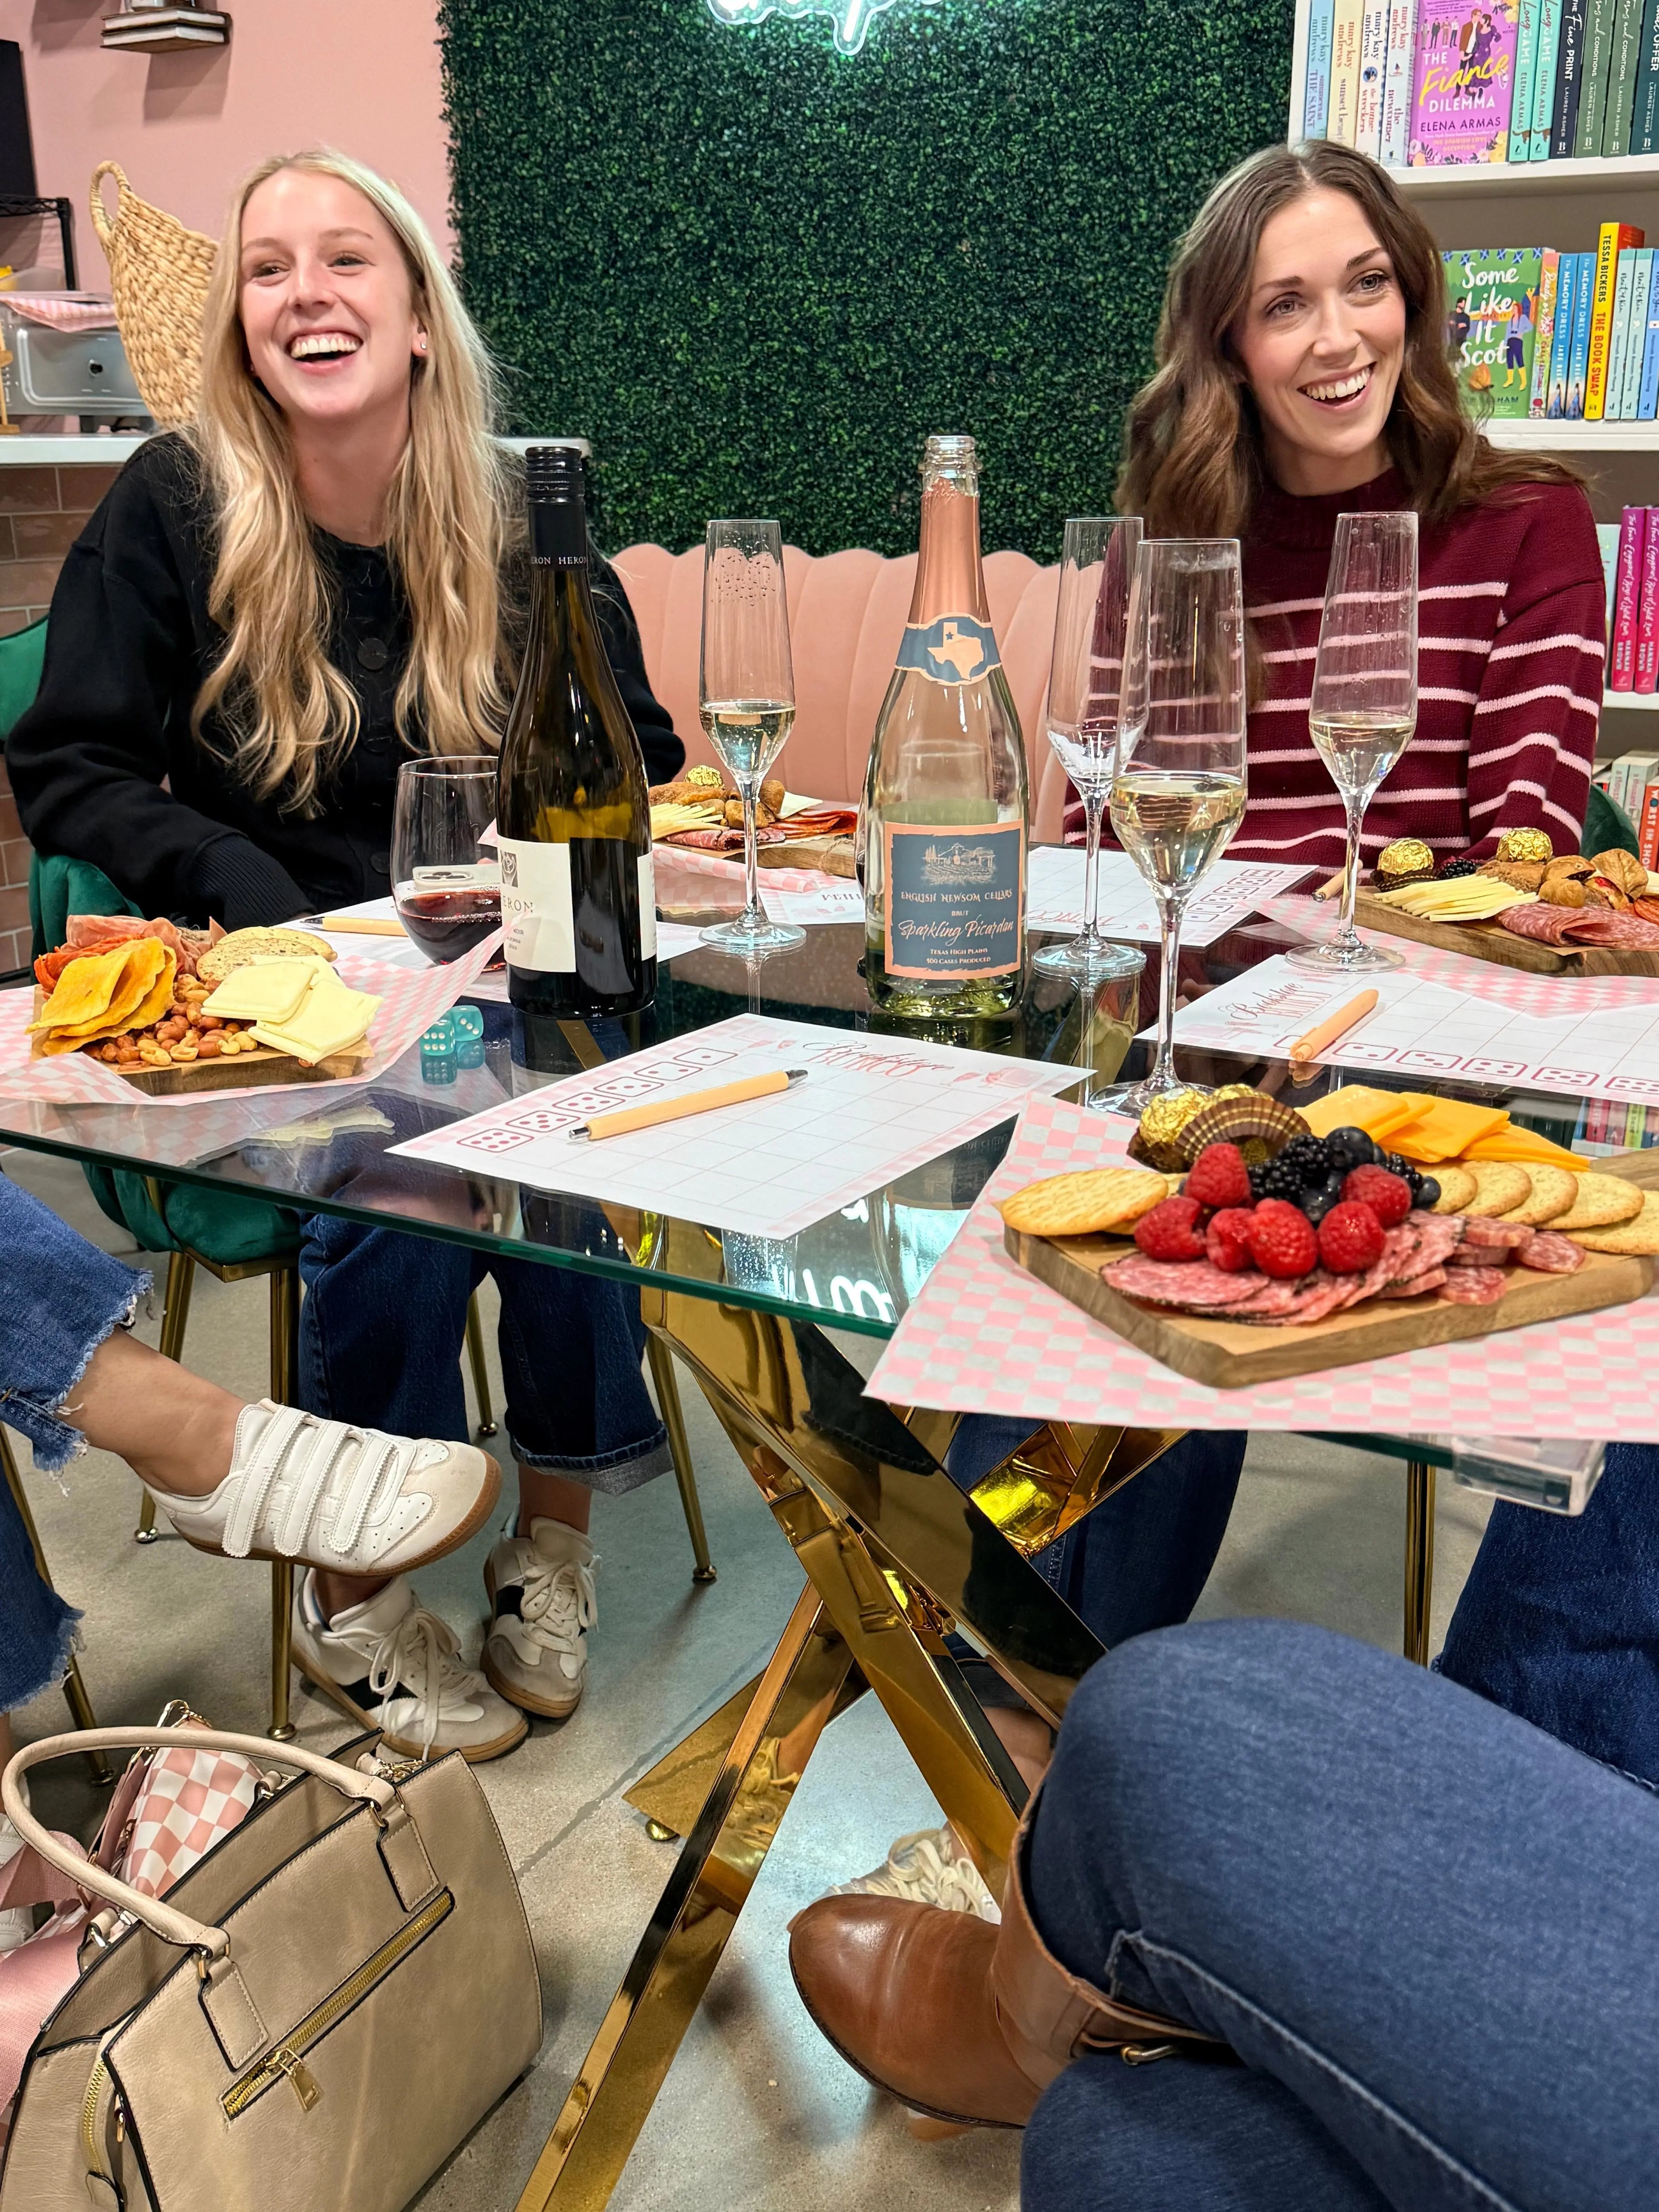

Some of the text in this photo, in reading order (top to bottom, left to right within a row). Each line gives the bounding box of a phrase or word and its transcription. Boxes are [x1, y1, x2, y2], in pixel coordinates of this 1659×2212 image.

[1565, 14, 1582, 46] Fine
[1423, 52, 1448, 65] THE
[1520, 29, 1532, 65] GAME
[1541, 27, 1553, 63] GAME
[1650, 34, 1659, 71] OFFER
[1419, 46, 1510, 106] Fiancé
[1565, 50, 1575, 81] PRINT
[1429, 95, 1495, 113] DILEMMA
[1516, 72, 1527, 129] ELENA ARMAS
[1537, 100, 1546, 128] ARMAS
[1420, 117, 1501, 132] ELENA ARMAS
[1462, 261, 1519, 289] Some
[1598, 235, 1611, 303] TESSA BICKERS
[1464, 286, 1513, 316] Like
[1561, 271, 1570, 310] MEMORY
[1580, 270, 1589, 309] MEMORY
[1475, 319, 1497, 345] It
[1559, 312, 1568, 339] DRESS
[1577, 311, 1586, 338] DRESS
[1596, 313, 1606, 331] THE
[1460, 340, 1510, 368] Scot
[1592, 334, 1604, 364] BOOK
[1590, 367, 1601, 396] SWAP
[503, 895, 533, 913] ERON
[901, 889, 1013, 903] ENGLISH NEWSOM CELLARS
[898, 920, 964, 946] Sparkling
[965, 914, 1014, 939] Picardan
[804, 1049, 920, 1077] BUNCO
